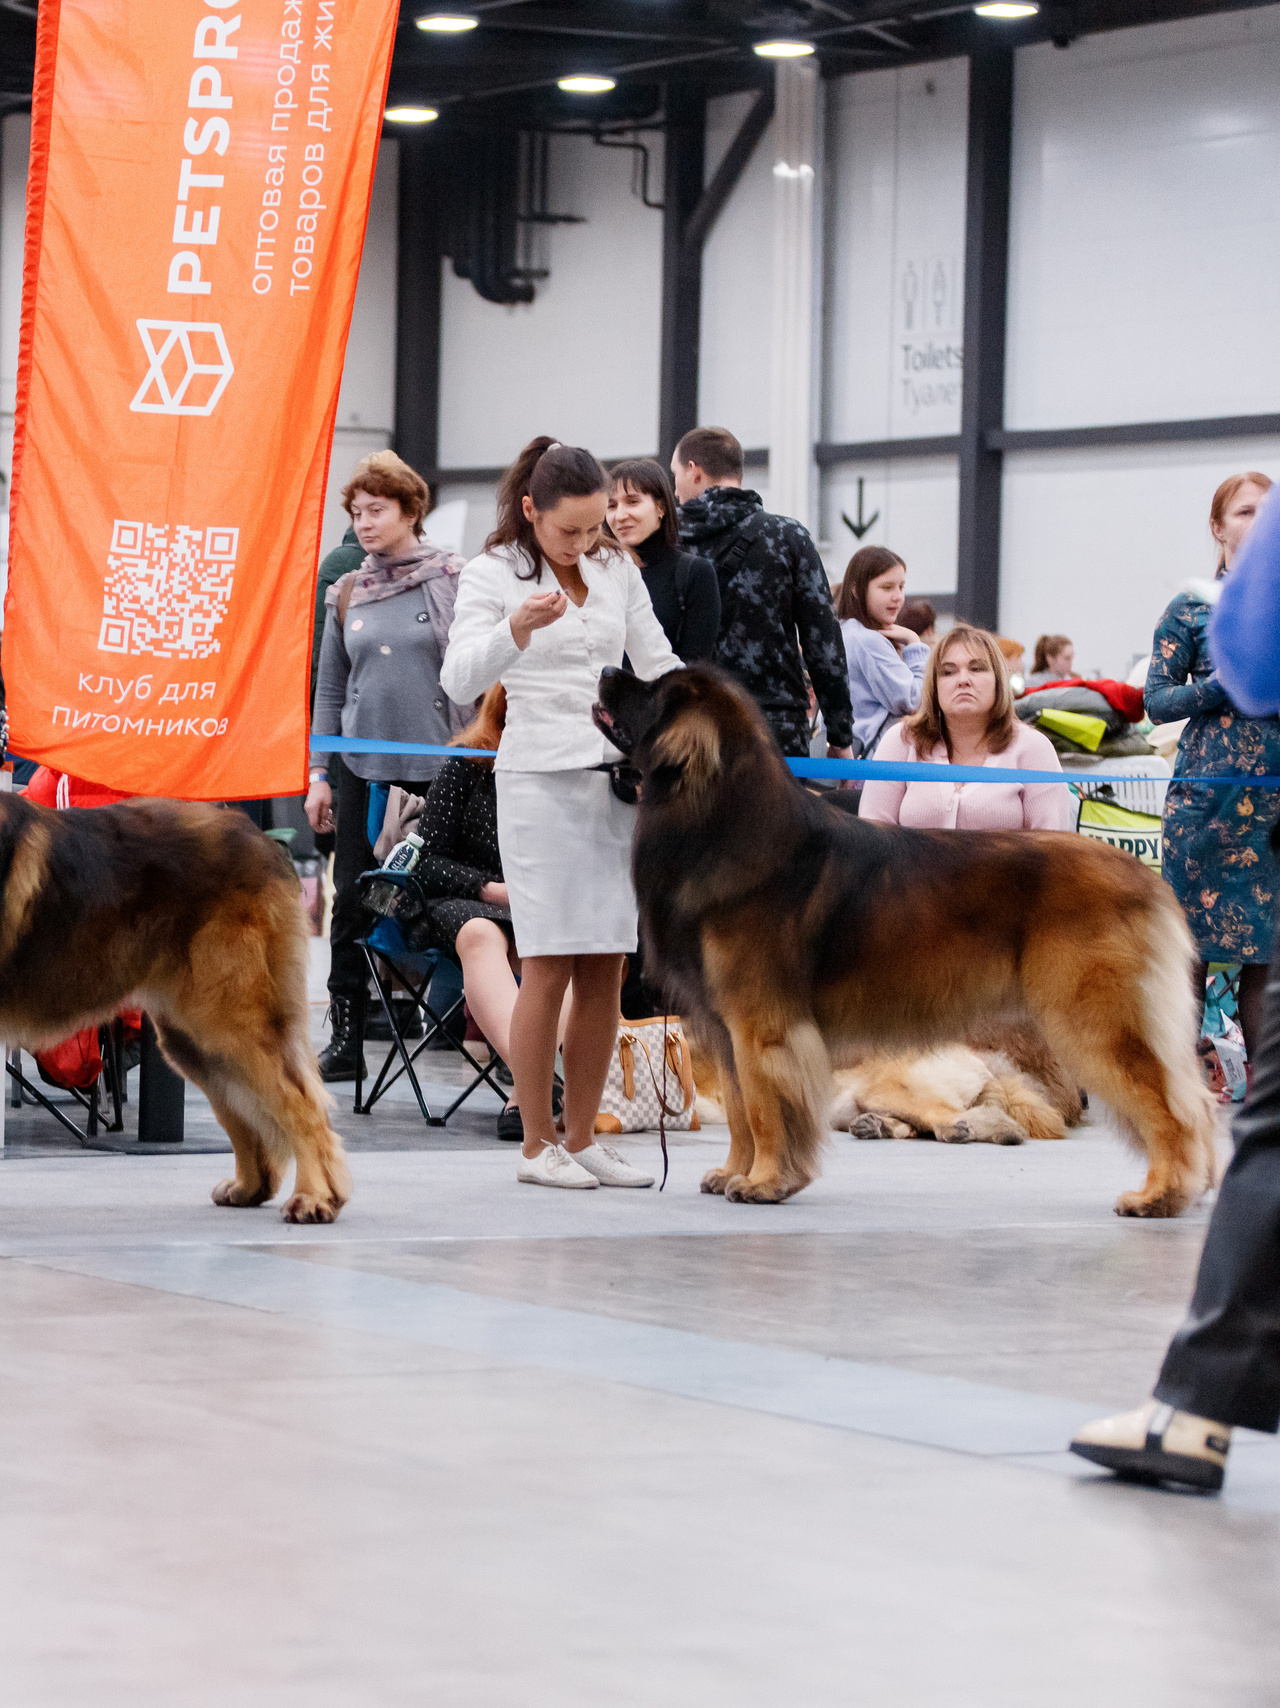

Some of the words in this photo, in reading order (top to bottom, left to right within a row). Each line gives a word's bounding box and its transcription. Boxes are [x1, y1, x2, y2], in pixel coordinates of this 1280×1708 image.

[307, 64, 333, 132] для
[167, 0, 242, 294] PETSPR
[252, 145, 288, 295] оптовая
[290, 143, 327, 296] товаров
[901, 341, 962, 372] Toilets
[78, 673, 154, 704] клуб
[158, 681, 217, 706] для
[51, 705, 229, 738] питомников
[1089, 834, 1159, 859] PPY
